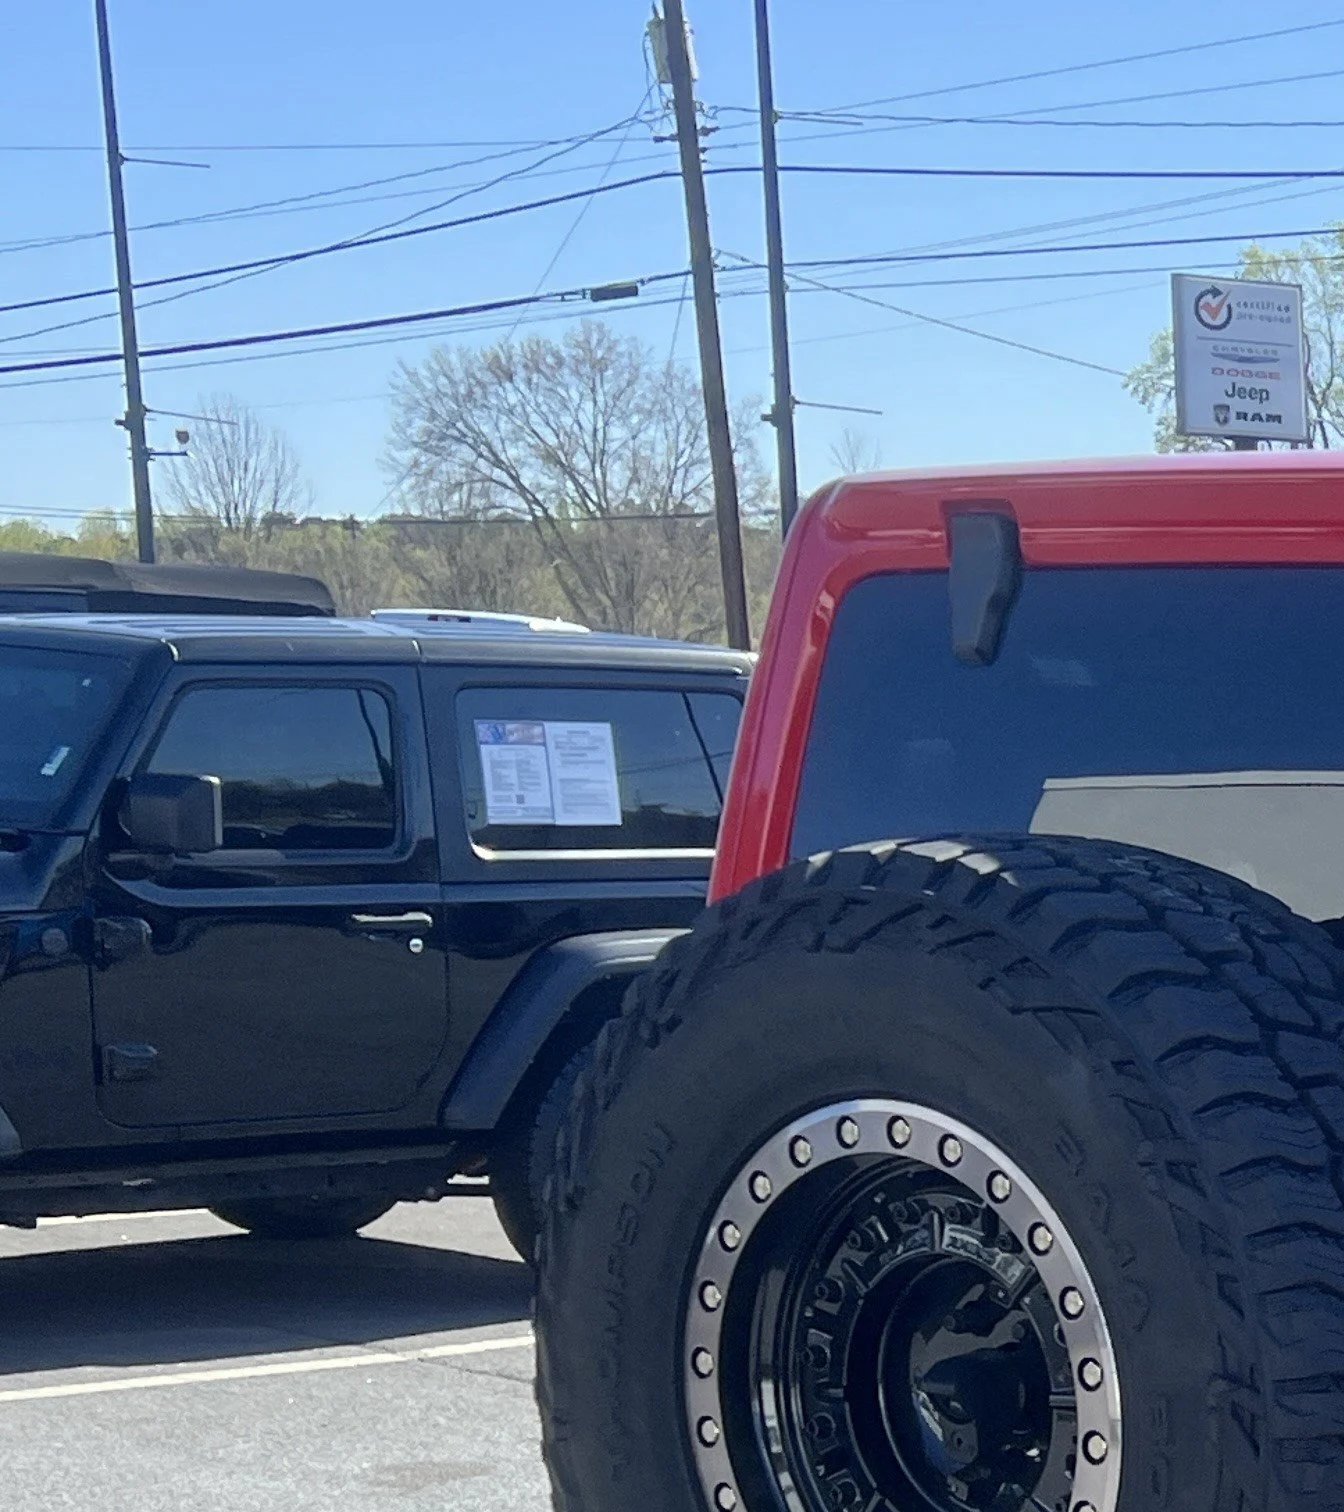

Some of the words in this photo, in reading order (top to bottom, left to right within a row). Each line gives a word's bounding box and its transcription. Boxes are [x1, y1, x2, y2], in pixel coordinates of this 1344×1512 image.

[1211, 367, 1281, 380] DODGE
[1224, 382, 1270, 405] Jeep
[1235, 411, 1282, 424] RAM
